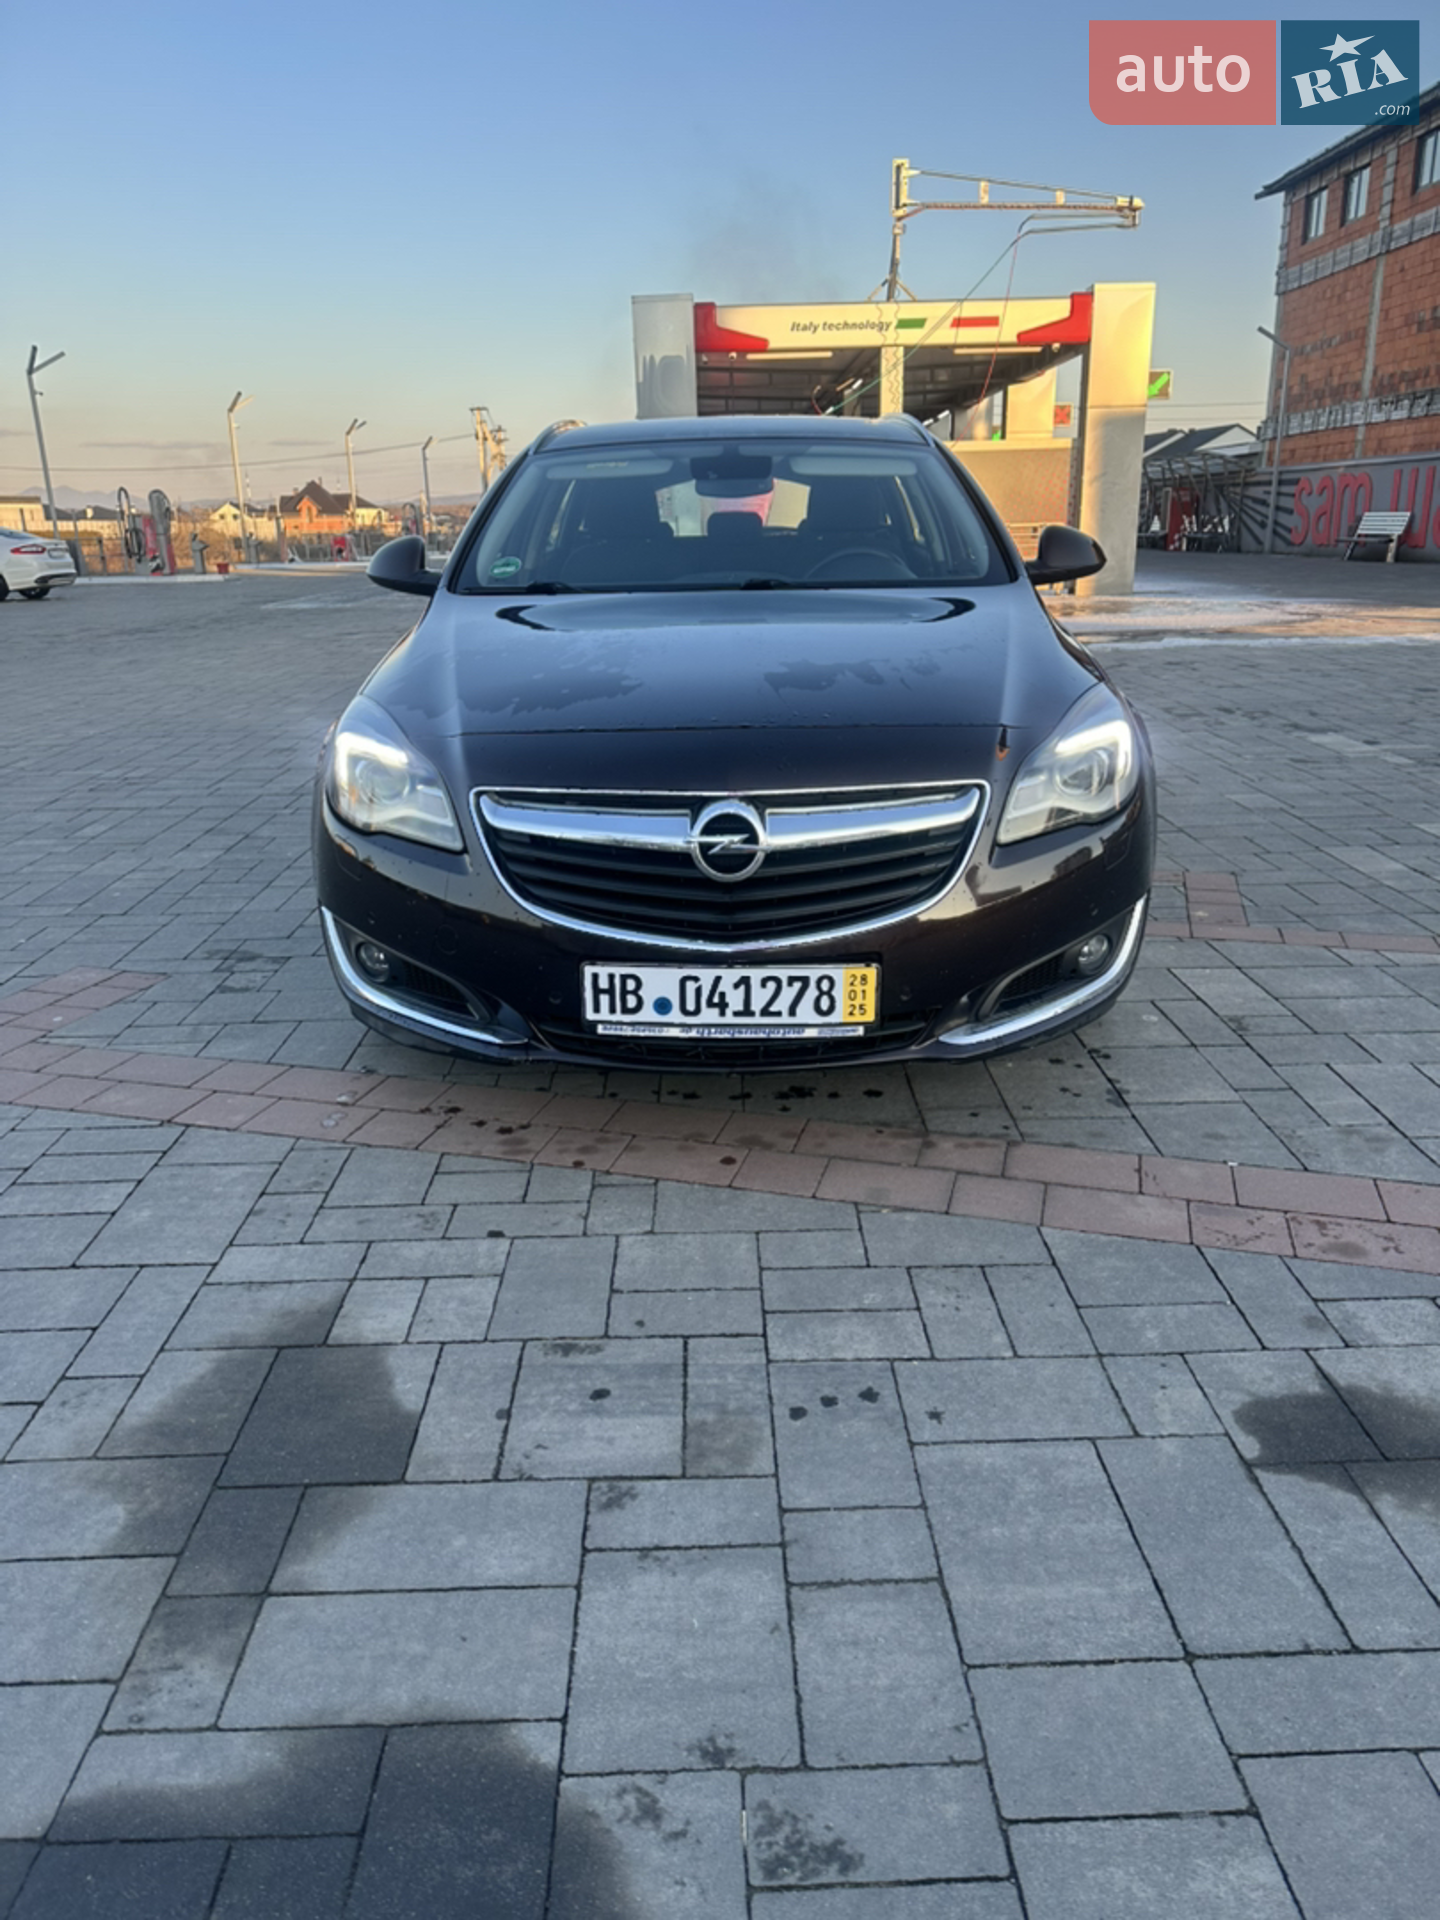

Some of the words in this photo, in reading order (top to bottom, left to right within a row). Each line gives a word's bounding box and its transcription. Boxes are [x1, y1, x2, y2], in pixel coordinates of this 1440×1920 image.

[790, 321, 820, 334] Italy
[821, 319, 893, 332] technology
[1290, 472, 1373, 548] sam
[849, 973, 868, 987] 28
[590, 972, 644, 1015] HB
[678, 974, 836, 1018] 041278
[848, 988, 867, 1001] 01
[848, 1003, 868, 1016] 25
